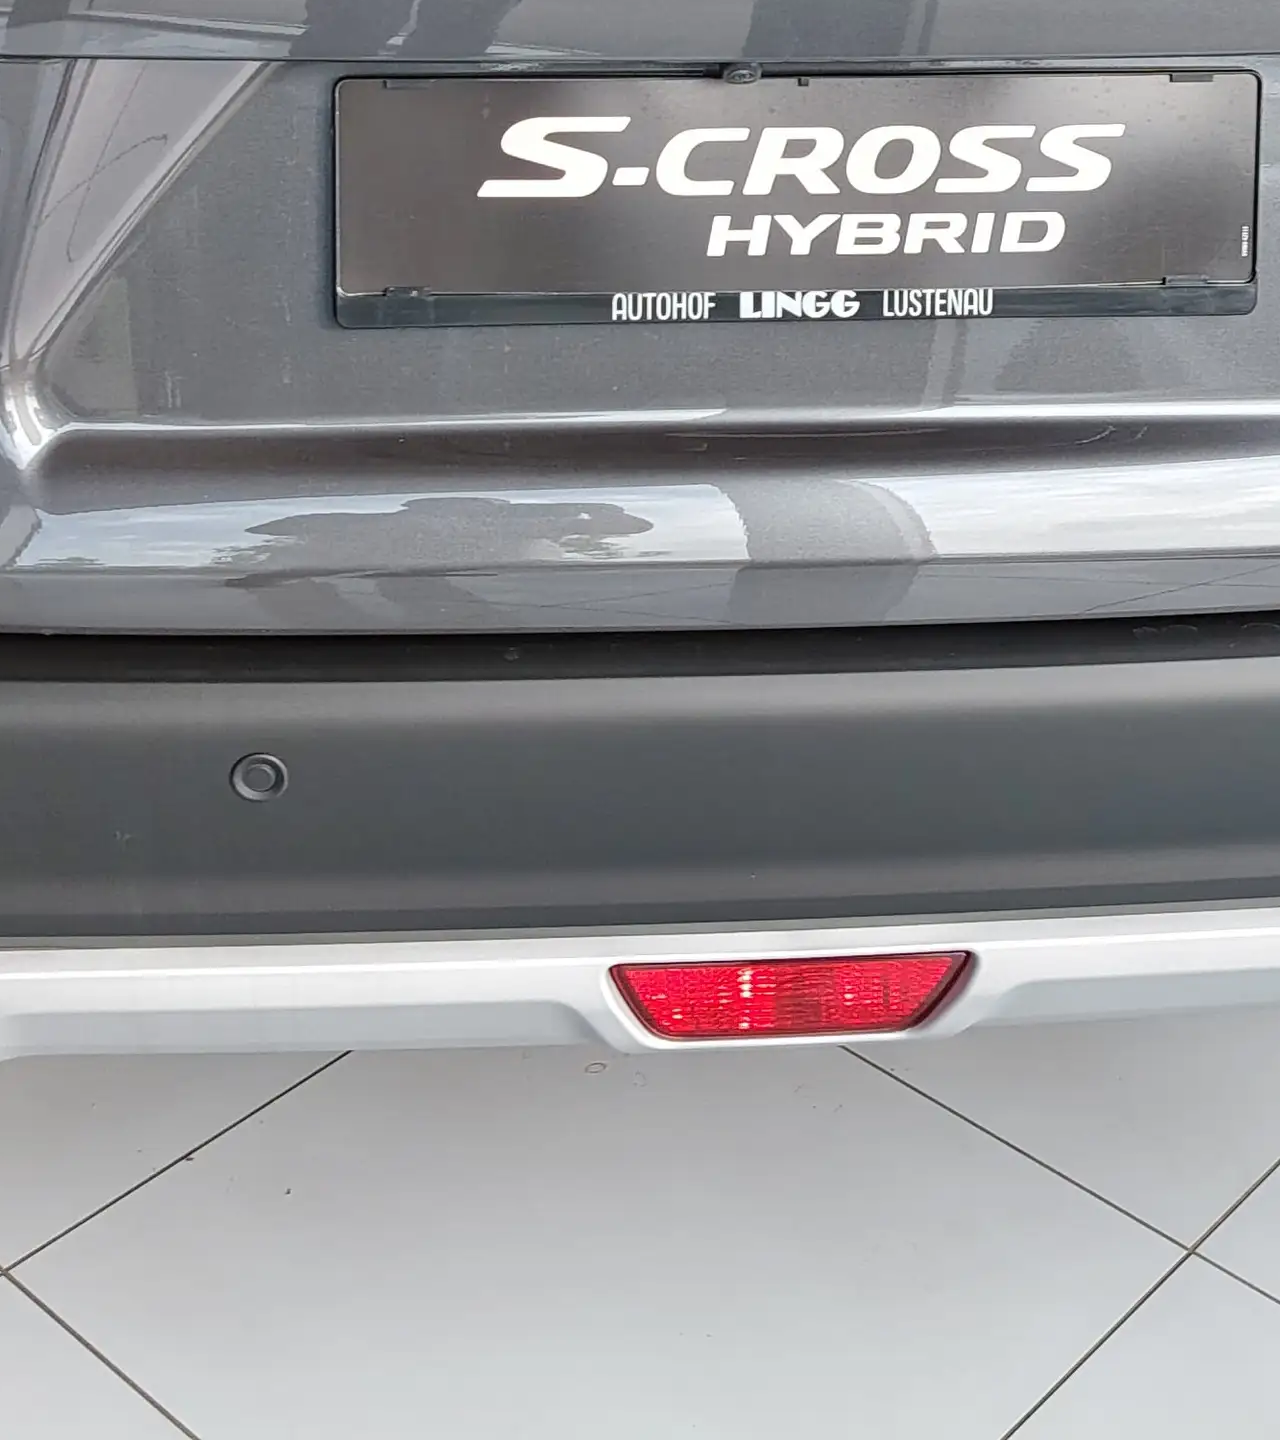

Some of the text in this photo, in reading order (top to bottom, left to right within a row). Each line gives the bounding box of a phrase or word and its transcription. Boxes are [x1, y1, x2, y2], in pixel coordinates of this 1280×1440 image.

[476, 115, 1125, 199] S-CROSS
[706, 211, 1066, 257] HYBRID
[611, 288, 994, 321] AUTOHOF LINGG LUSTENAU
